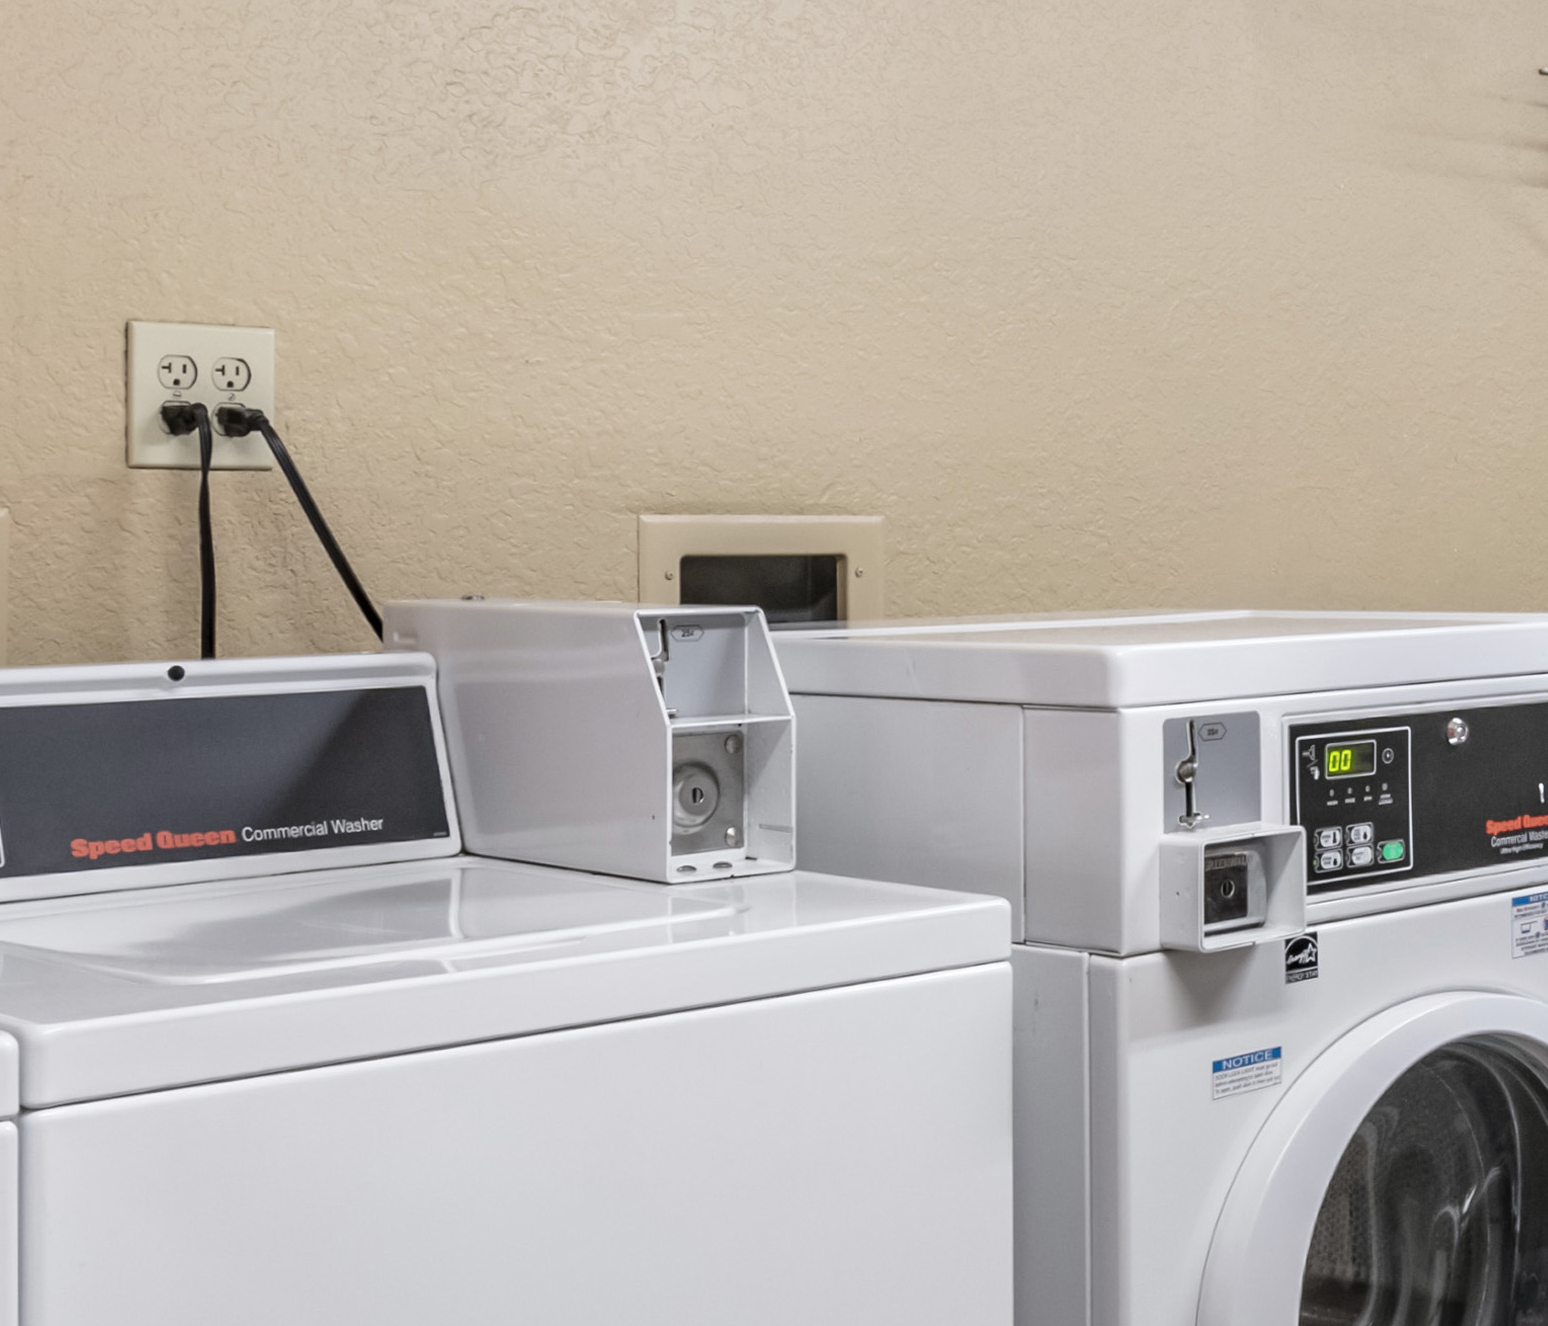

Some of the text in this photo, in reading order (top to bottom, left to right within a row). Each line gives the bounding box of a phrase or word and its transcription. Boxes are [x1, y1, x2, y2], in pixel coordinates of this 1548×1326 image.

[1328, 749, 1352, 772] 00
[1486, 815, 1522, 835] Speed
[71, 817, 384, 860] Speed Queen Commercial Washer
[1490, 832, 1527, 848] Commercial
[1222, 1049, 1273, 1070] NOTICE
